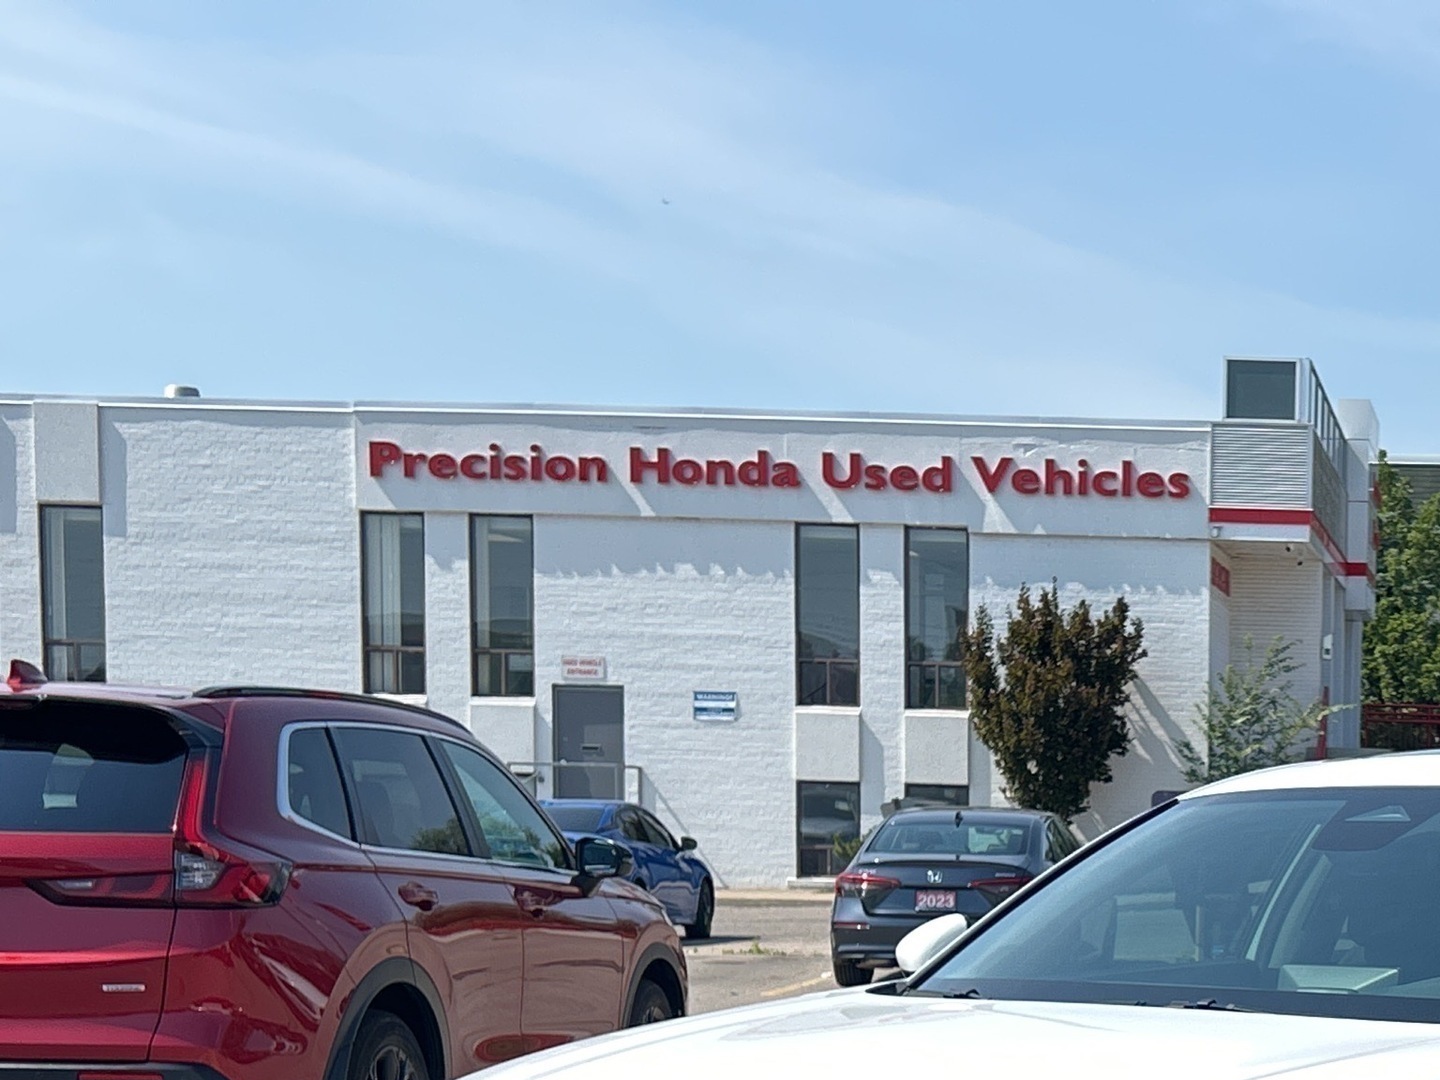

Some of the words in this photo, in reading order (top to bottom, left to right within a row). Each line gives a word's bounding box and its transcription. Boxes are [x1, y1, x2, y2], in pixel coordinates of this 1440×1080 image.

[368, 440, 608, 483] Precision
[629, 447, 799, 488] Honda
[821, 452, 953, 494] Used
[972, 456, 1190, 500] Vehicles
[917, 894, 955, 909] 2023
